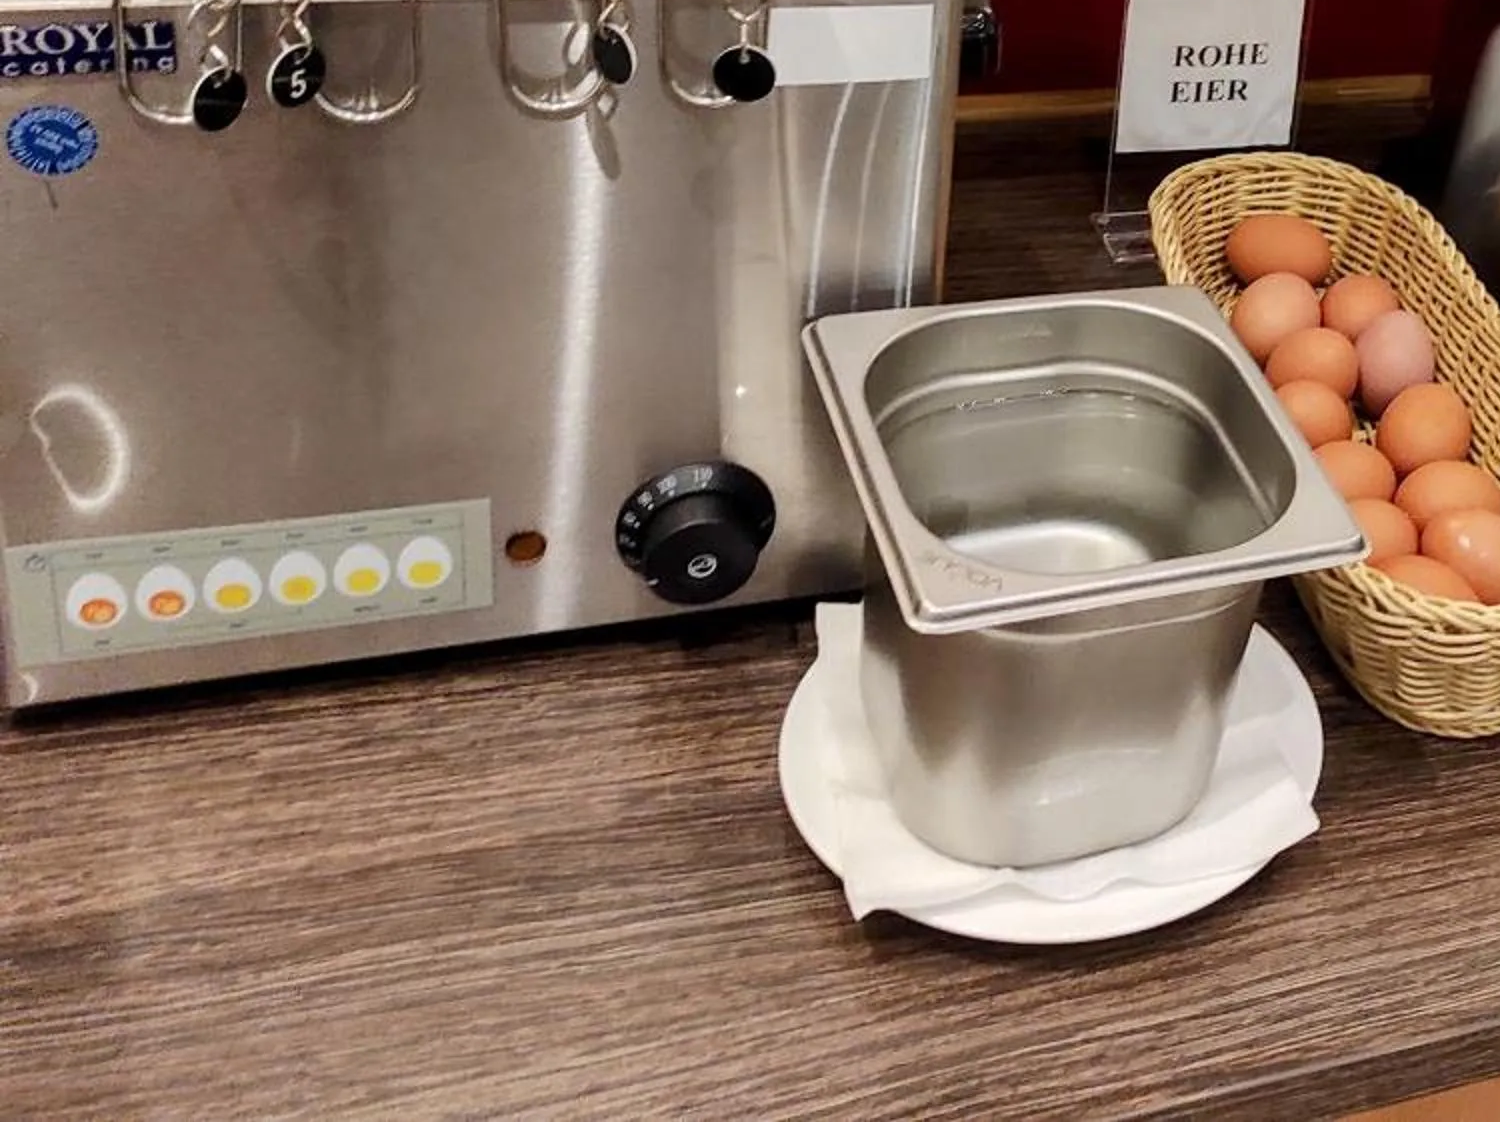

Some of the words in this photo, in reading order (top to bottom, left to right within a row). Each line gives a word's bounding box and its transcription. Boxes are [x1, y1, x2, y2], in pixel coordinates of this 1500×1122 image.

[0, 22, 174, 56] ROYAL
[2, 55, 175, 77] caterng
[1173, 42, 1269, 68] ROHE
[289, 68, 307, 98] 5
[1170, 79, 1249, 104] EIER
